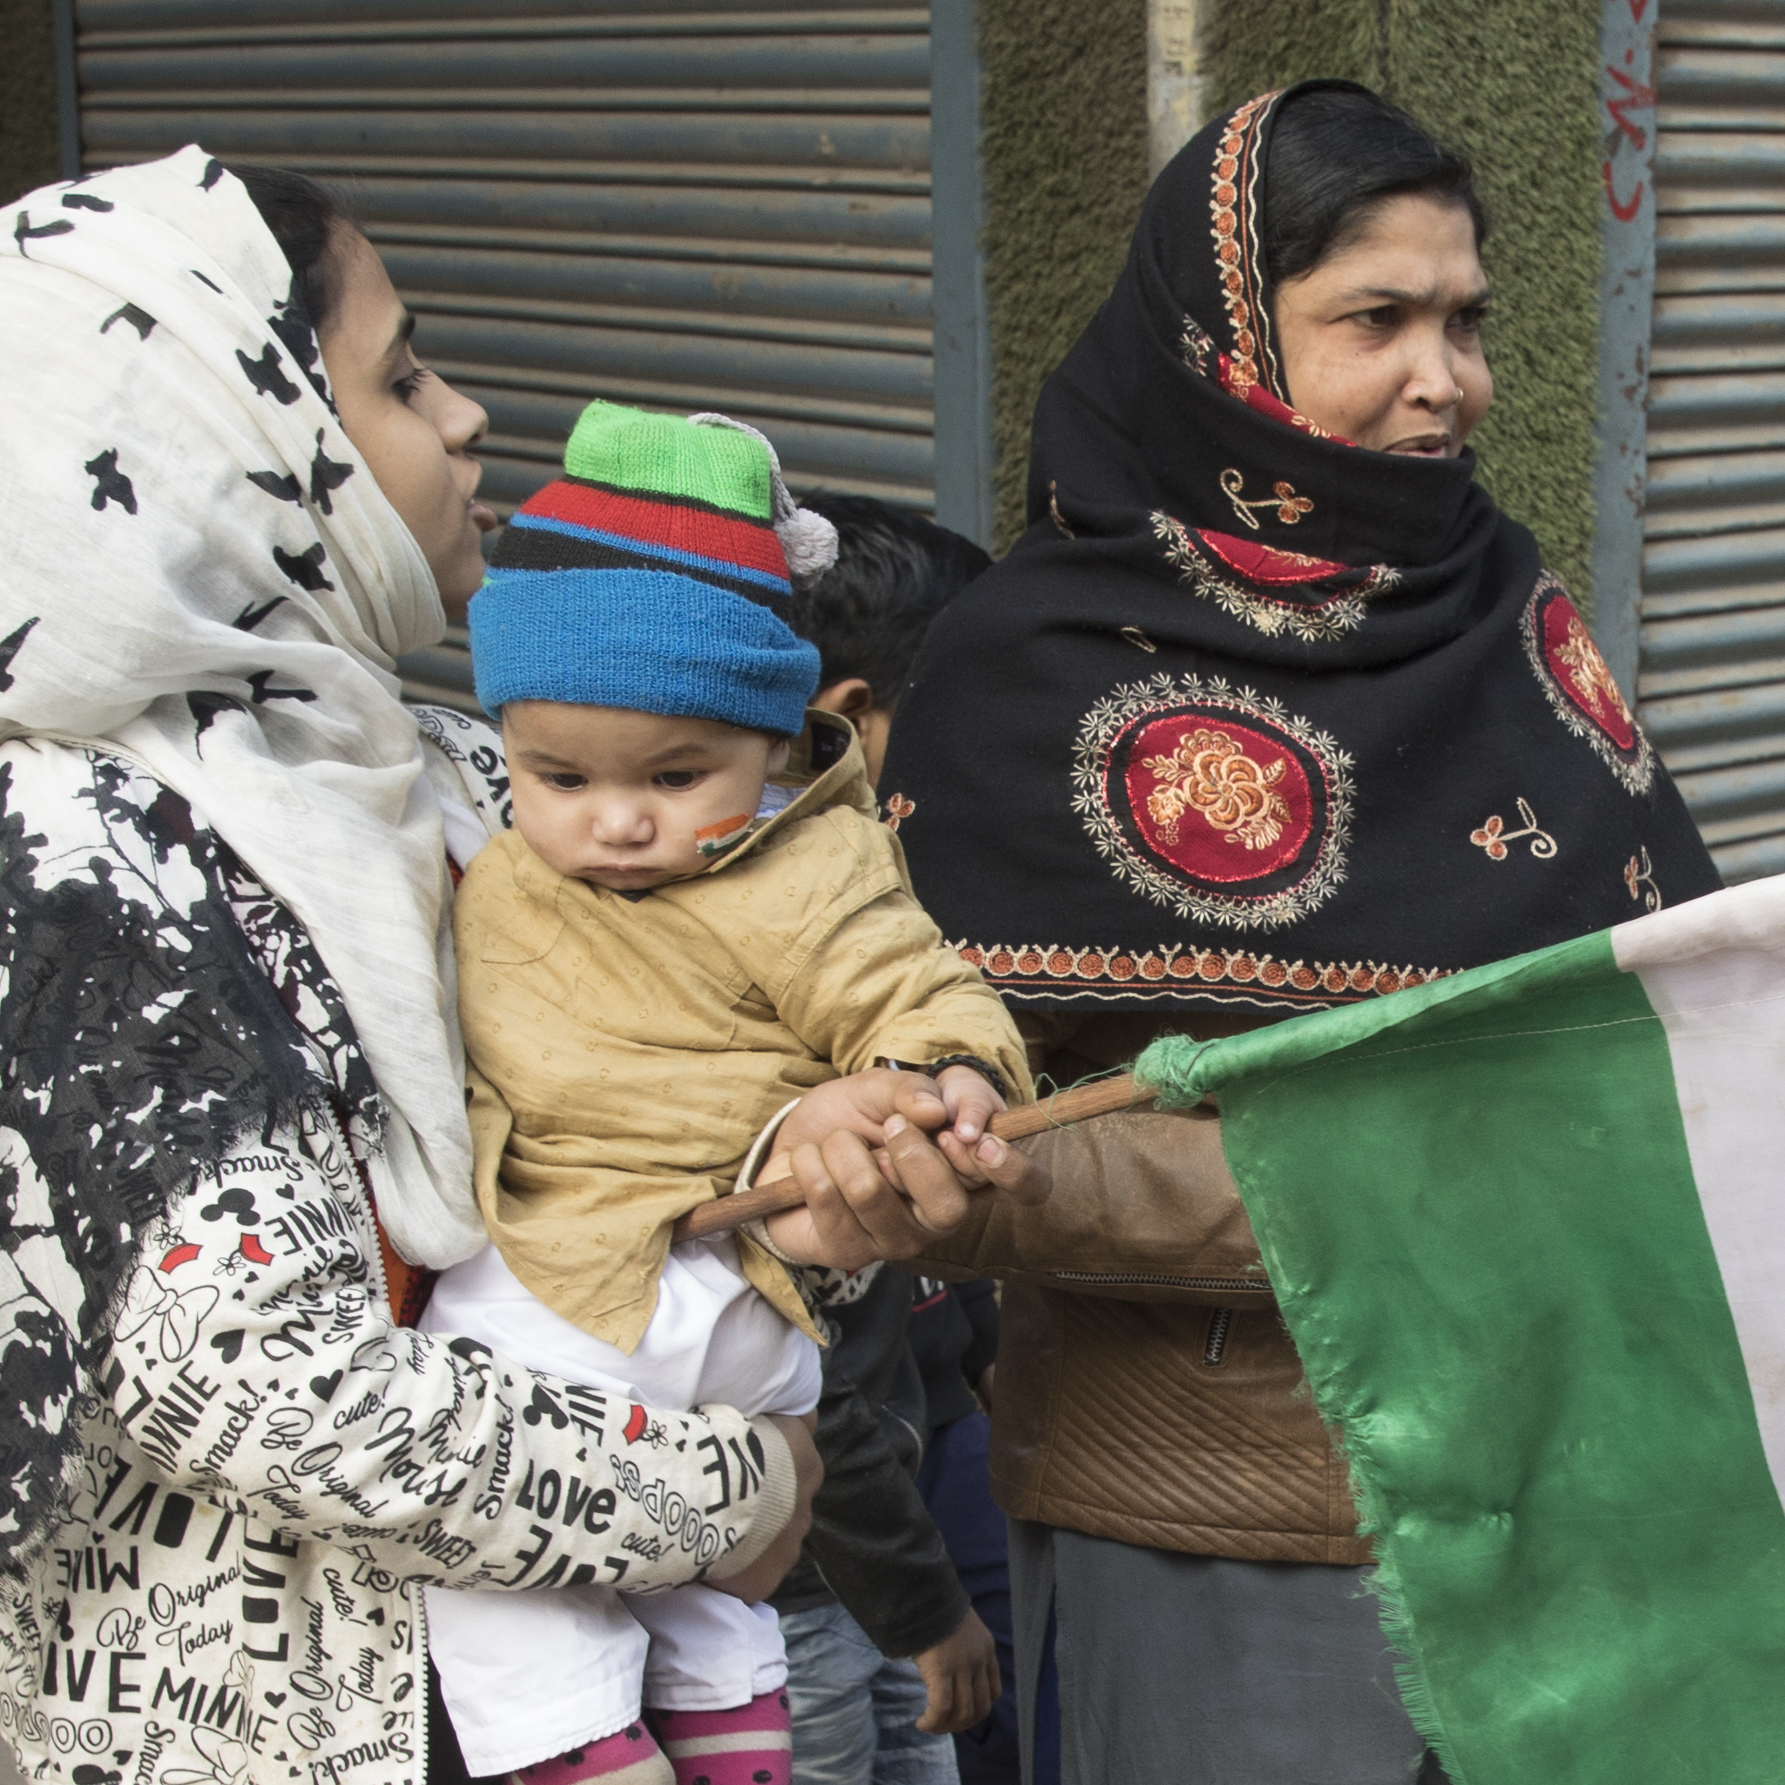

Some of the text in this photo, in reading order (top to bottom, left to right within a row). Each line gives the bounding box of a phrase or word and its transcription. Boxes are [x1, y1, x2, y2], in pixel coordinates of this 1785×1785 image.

[260, 1407, 314, 1450] Be
[333, 1380, 390, 1430] cute!
[246, 1464, 311, 1520] Today
[291, 1442, 389, 1518] Original
[515, 1459, 617, 1534] Love
[620, 1532, 675, 1562] cute!
[96, 1551, 241, 1650] Be Original
[323, 1567, 368, 1627] cute!
[156, 1620, 233, 1667] Today
[287, 1596, 336, 1751] Be Original
[336, 1646, 385, 1712] Today
